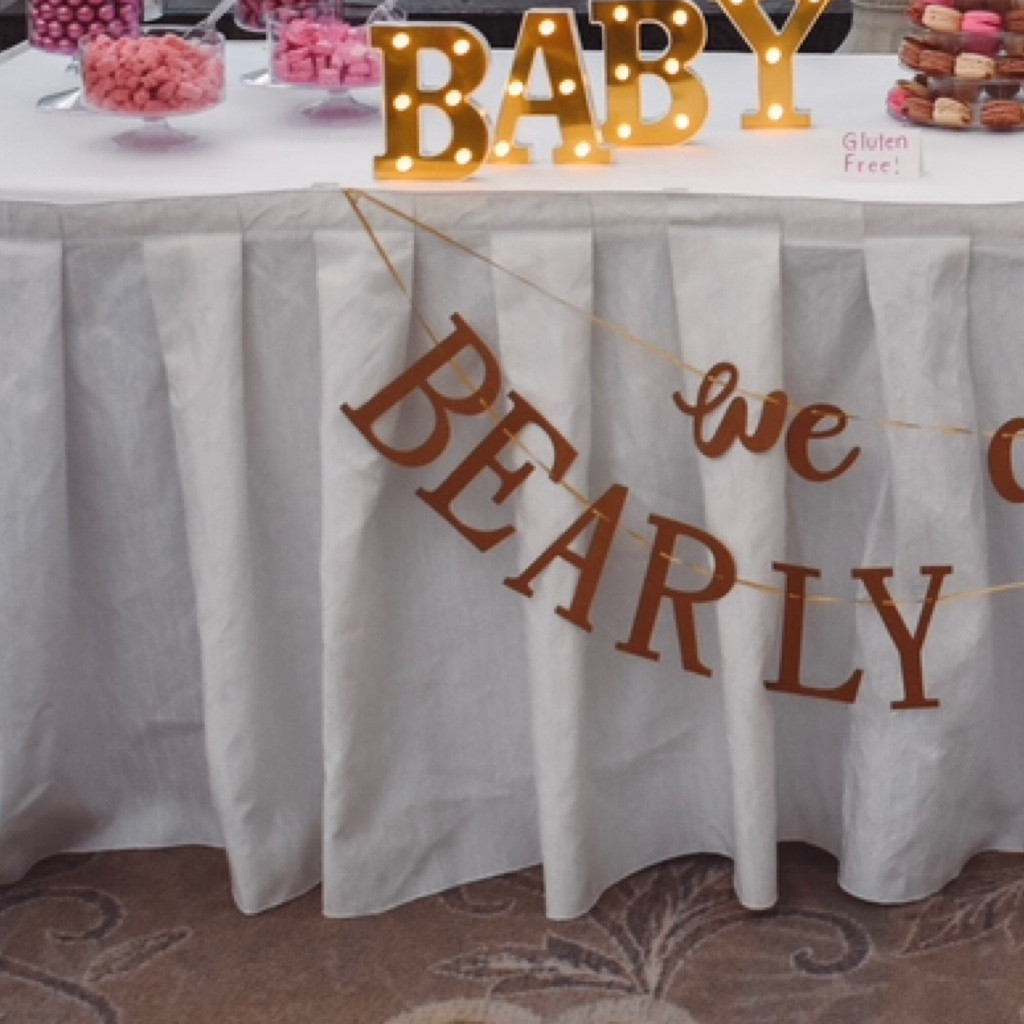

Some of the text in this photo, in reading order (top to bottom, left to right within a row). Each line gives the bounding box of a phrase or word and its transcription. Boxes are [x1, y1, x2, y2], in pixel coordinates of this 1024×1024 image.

[842, 131, 908, 151] Gluten
[844, 153, 899, 175] Free!
[673, 362, 861, 482] we
[340, 312, 953, 710] BEARLY
